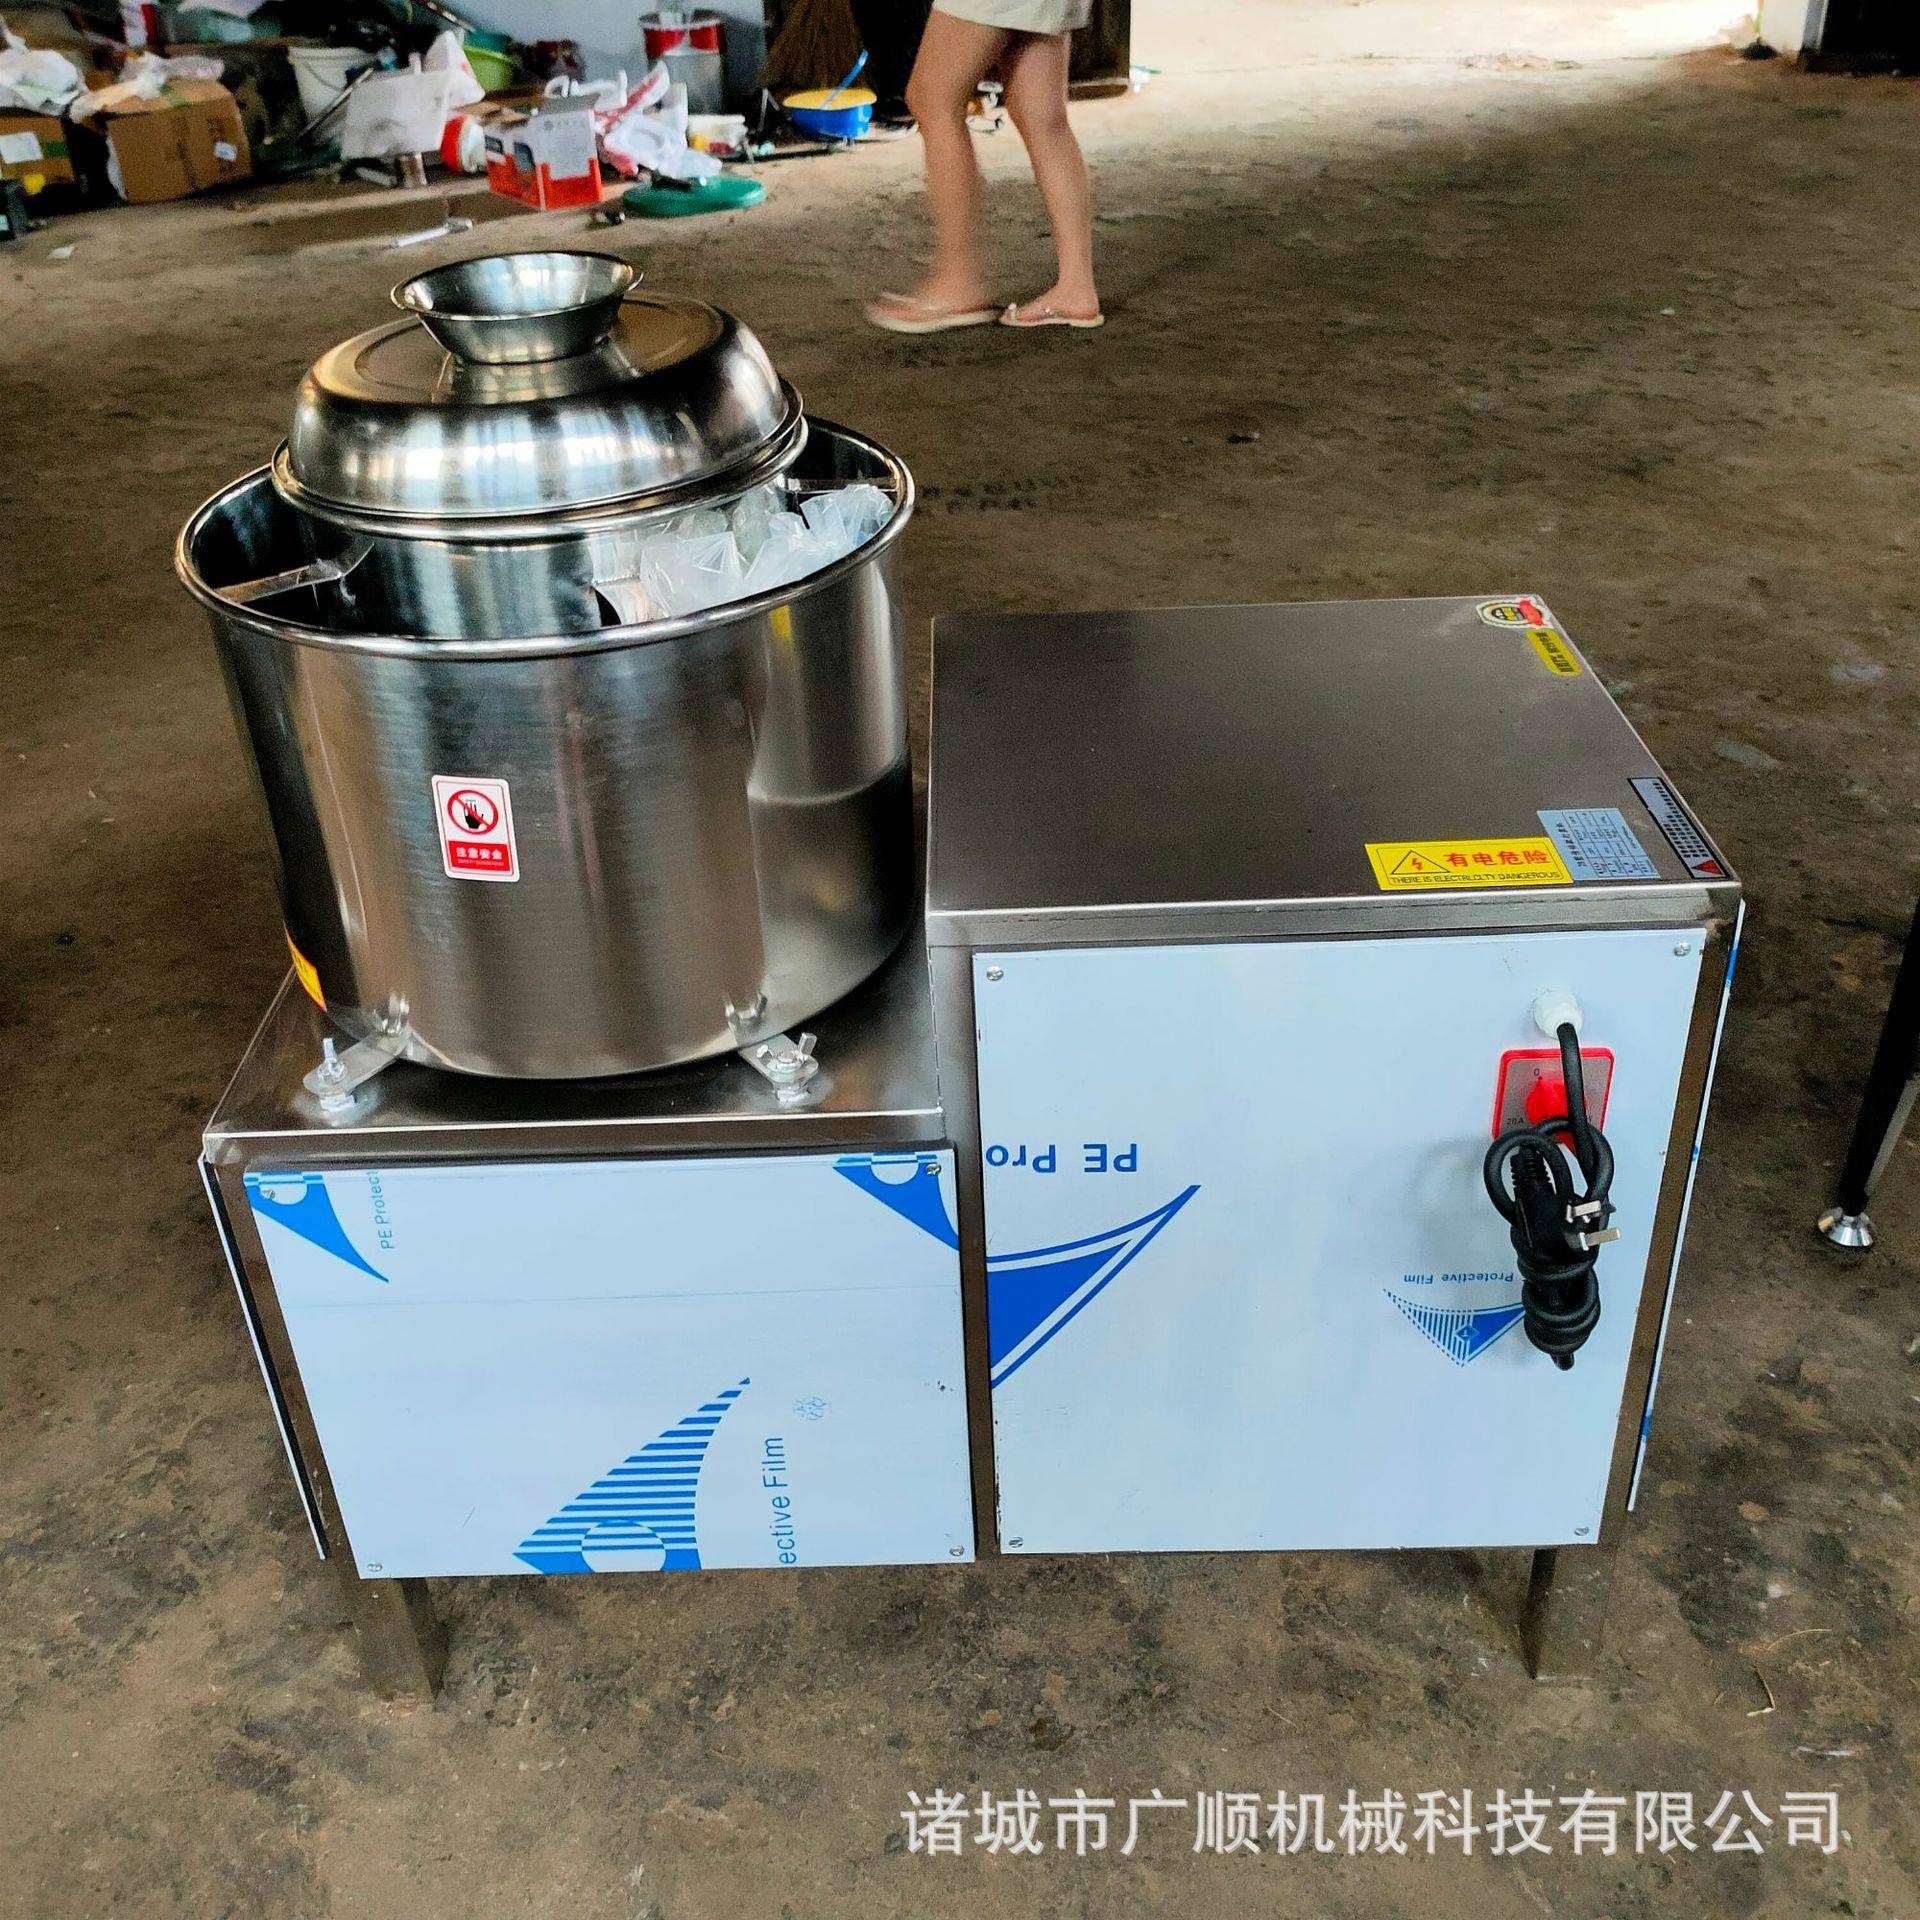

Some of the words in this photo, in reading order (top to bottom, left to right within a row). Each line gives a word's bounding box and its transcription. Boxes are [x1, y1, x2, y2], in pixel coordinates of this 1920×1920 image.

[1444, 849, 1550, 867] 有电危险
[1391, 876, 1422, 884] THERE
[1498, 871, 1562, 880] DANGEROUS
[985, 1144, 1057, 1174] Pro
[1083, 1143, 1138, 1173] PE
[378, 1229, 395, 1249] PE
[1403, 1274, 1434, 1285] Film
[1441, 1272, 1514, 1283] Protective
[762, 1437, 788, 1488] Film
[771, 1495, 797, 1565] ective
